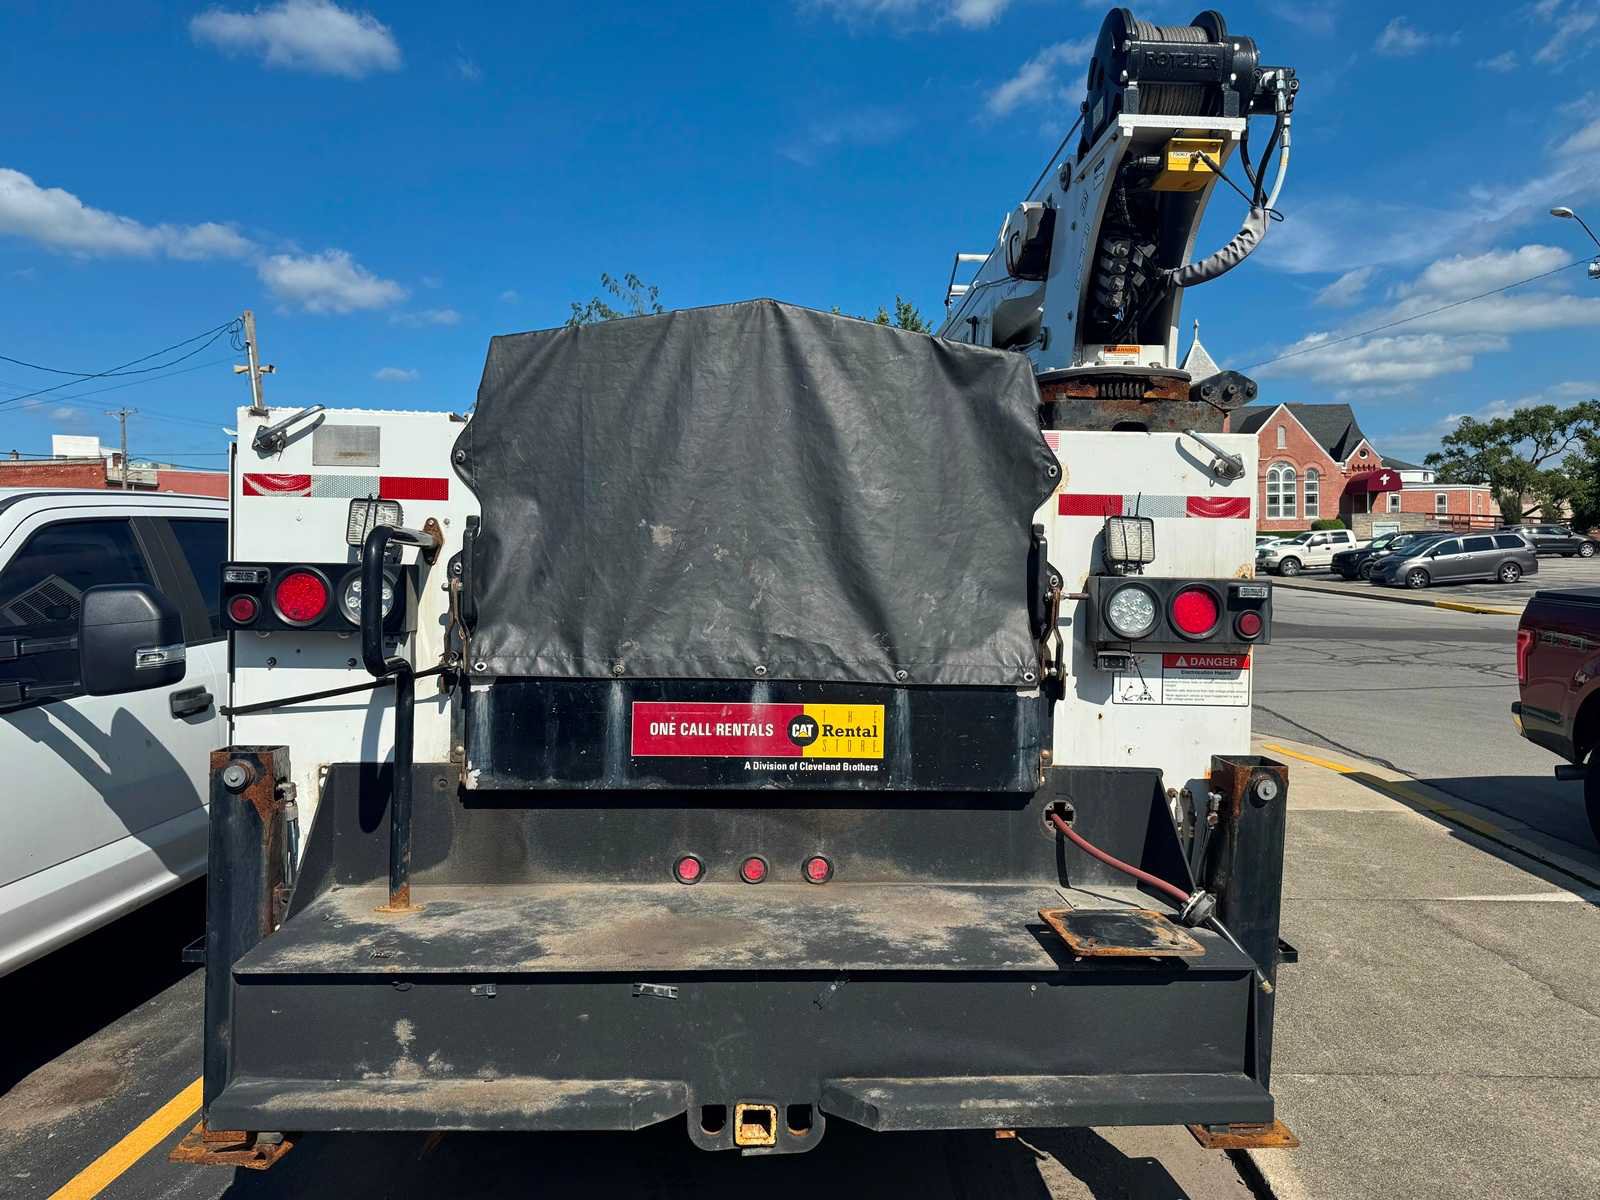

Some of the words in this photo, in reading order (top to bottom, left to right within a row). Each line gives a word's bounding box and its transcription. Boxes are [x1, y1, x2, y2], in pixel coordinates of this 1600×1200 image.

[1190, 657, 1238, 667] DANGER
[650, 722, 676, 736] ONE
[680, 722, 712, 736] CALL
[716, 723, 774, 737] RENTALS
[791, 723, 814, 738] CAT
[822, 724, 878, 738] Rental
[744, 761, 751, 770] A
[753, 762, 787, 771] Division
[789, 762, 798, 771] of
[799, 762, 841, 772] Cleveland
[843, 763, 879, 773] Brothers
